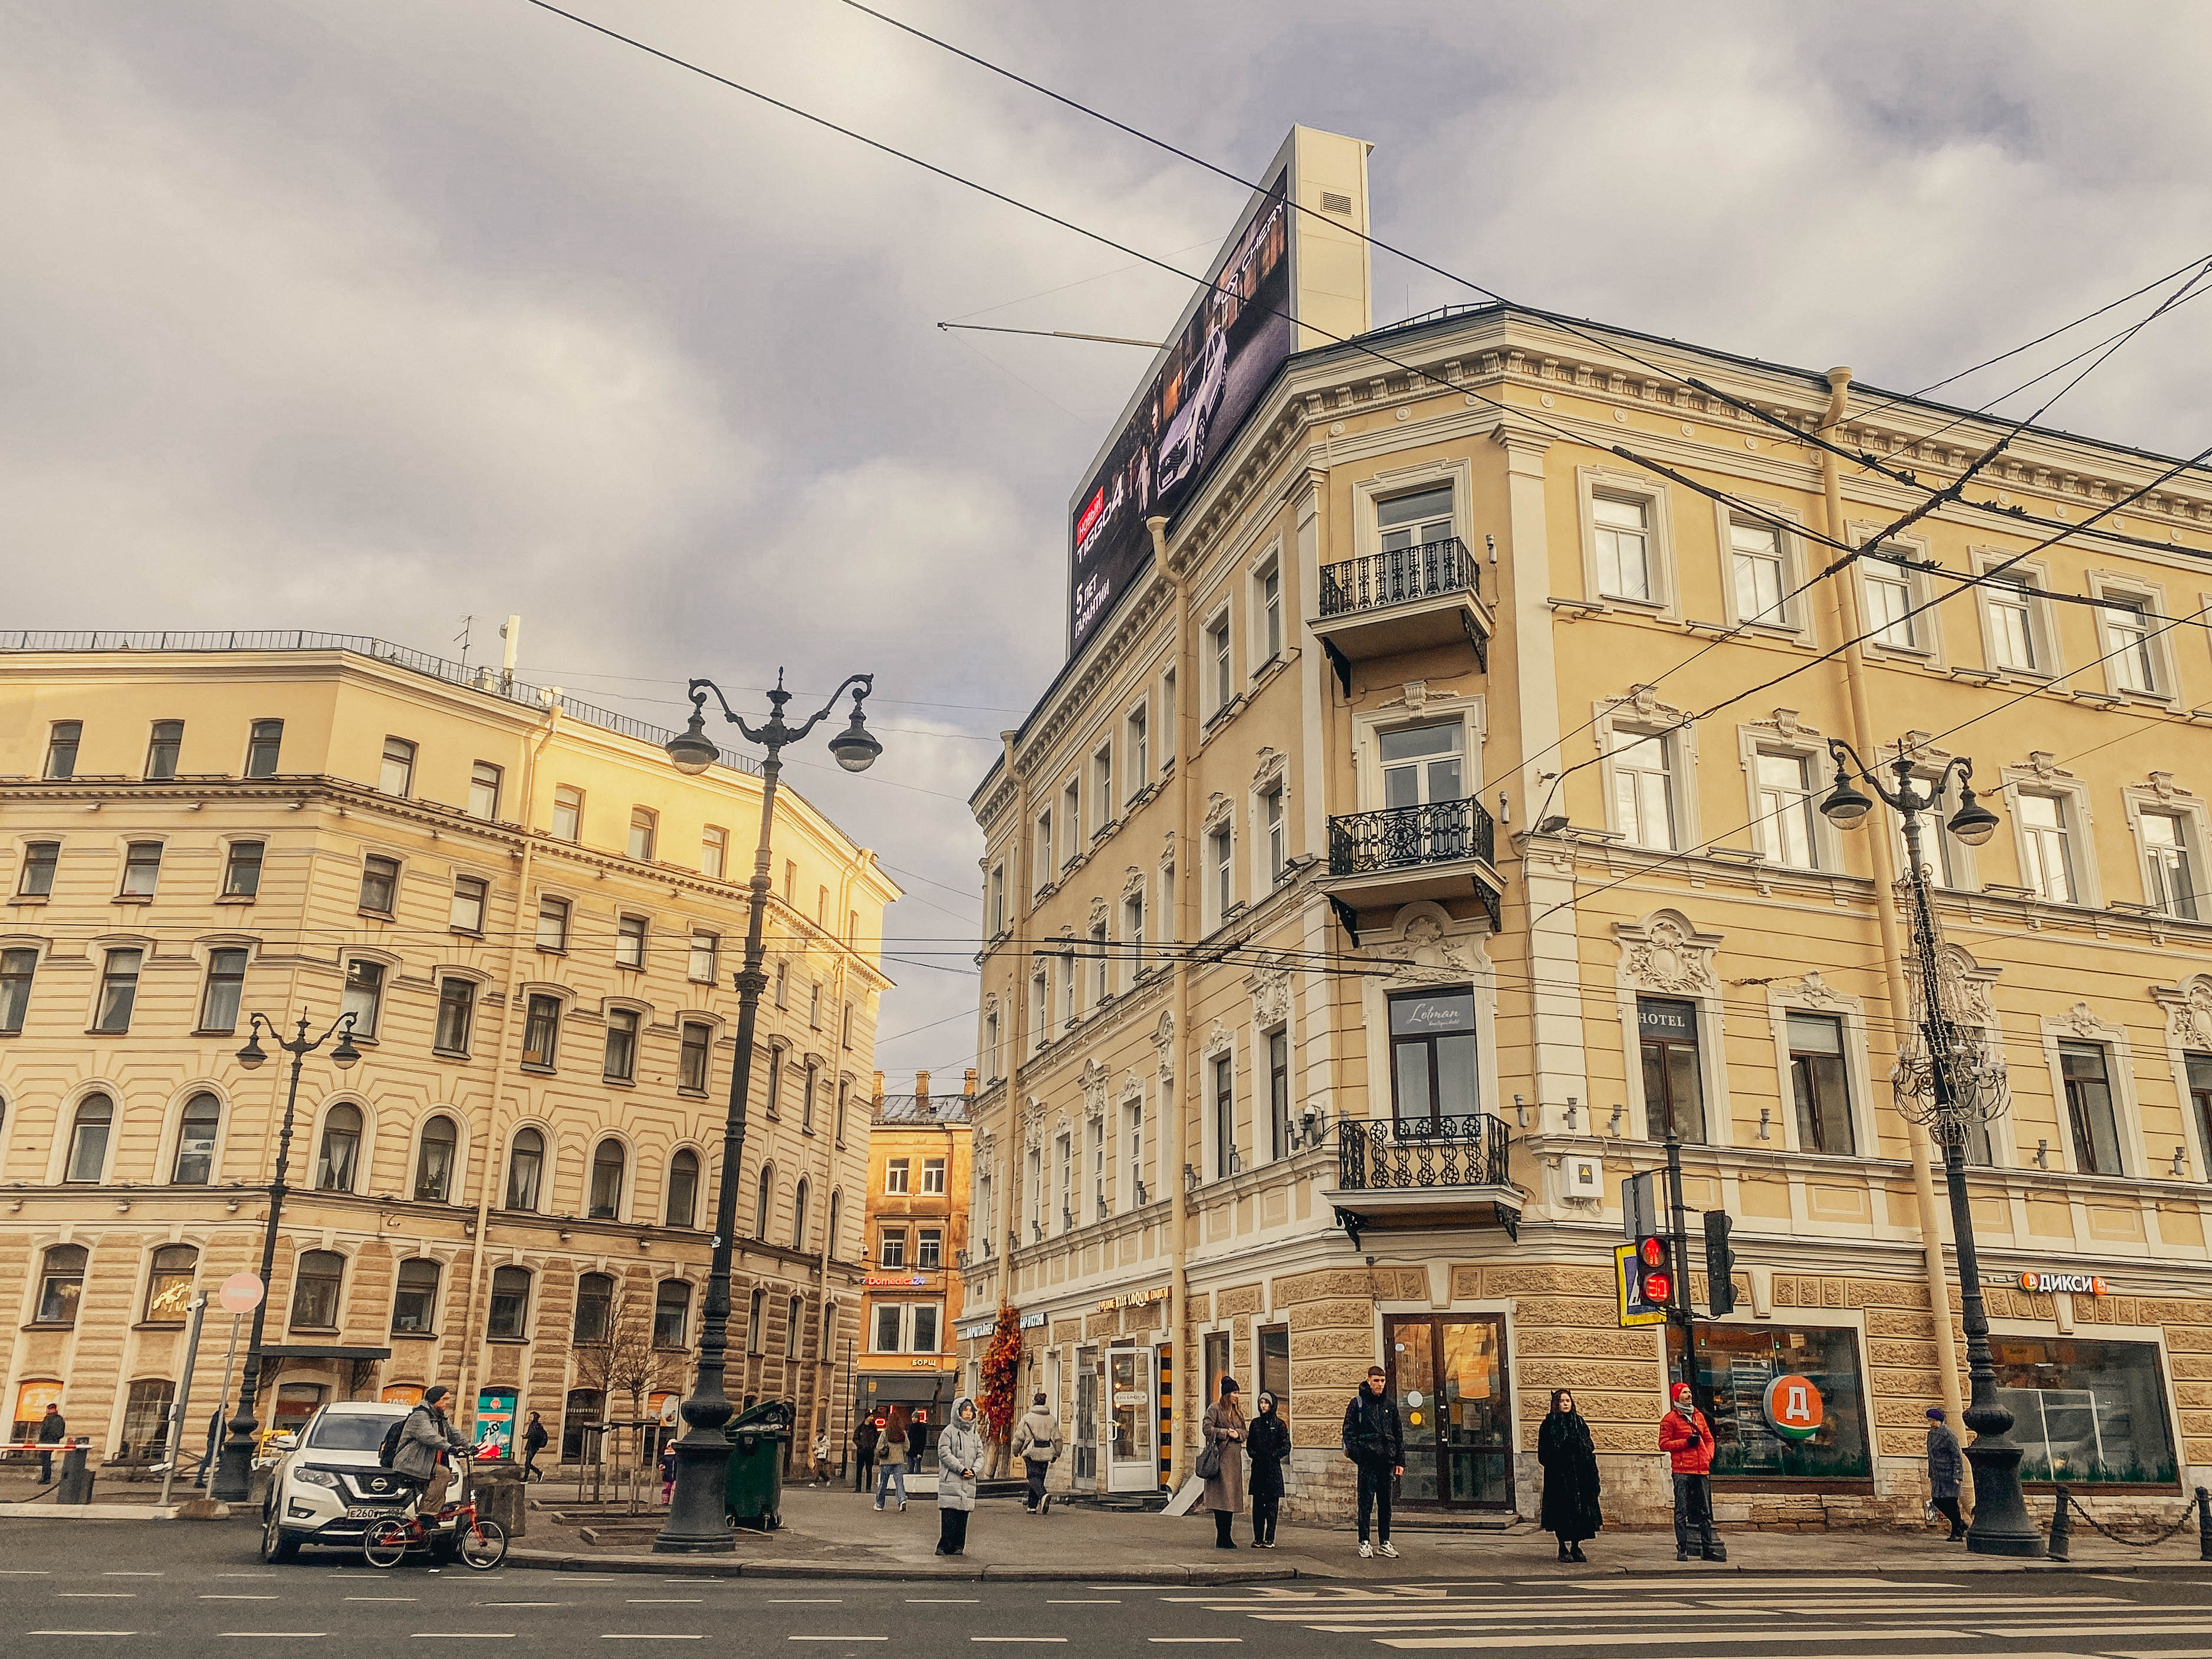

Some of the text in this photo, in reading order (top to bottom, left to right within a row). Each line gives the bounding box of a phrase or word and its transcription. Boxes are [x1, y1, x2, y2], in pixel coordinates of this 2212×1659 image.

[1241, 192, 1286, 272] CHERY
[1077, 471, 1124, 564] TIGGO 4
[1079, 495, 1101, 537] НОВЫЙ
[1074, 578, 1110, 639] ГАРАНТИИ
[1076, 573, 1098, 615] 5 ЛЕТ
[1406, 1003, 1459, 1024] Lotman
[1638, 1012, 1685, 1027] HOTEL
[1648, 1279, 1667, 1298] 30
[2039, 1274, 2093, 1293] ДИКСИ
[1786, 1386, 1810, 1421] Д
